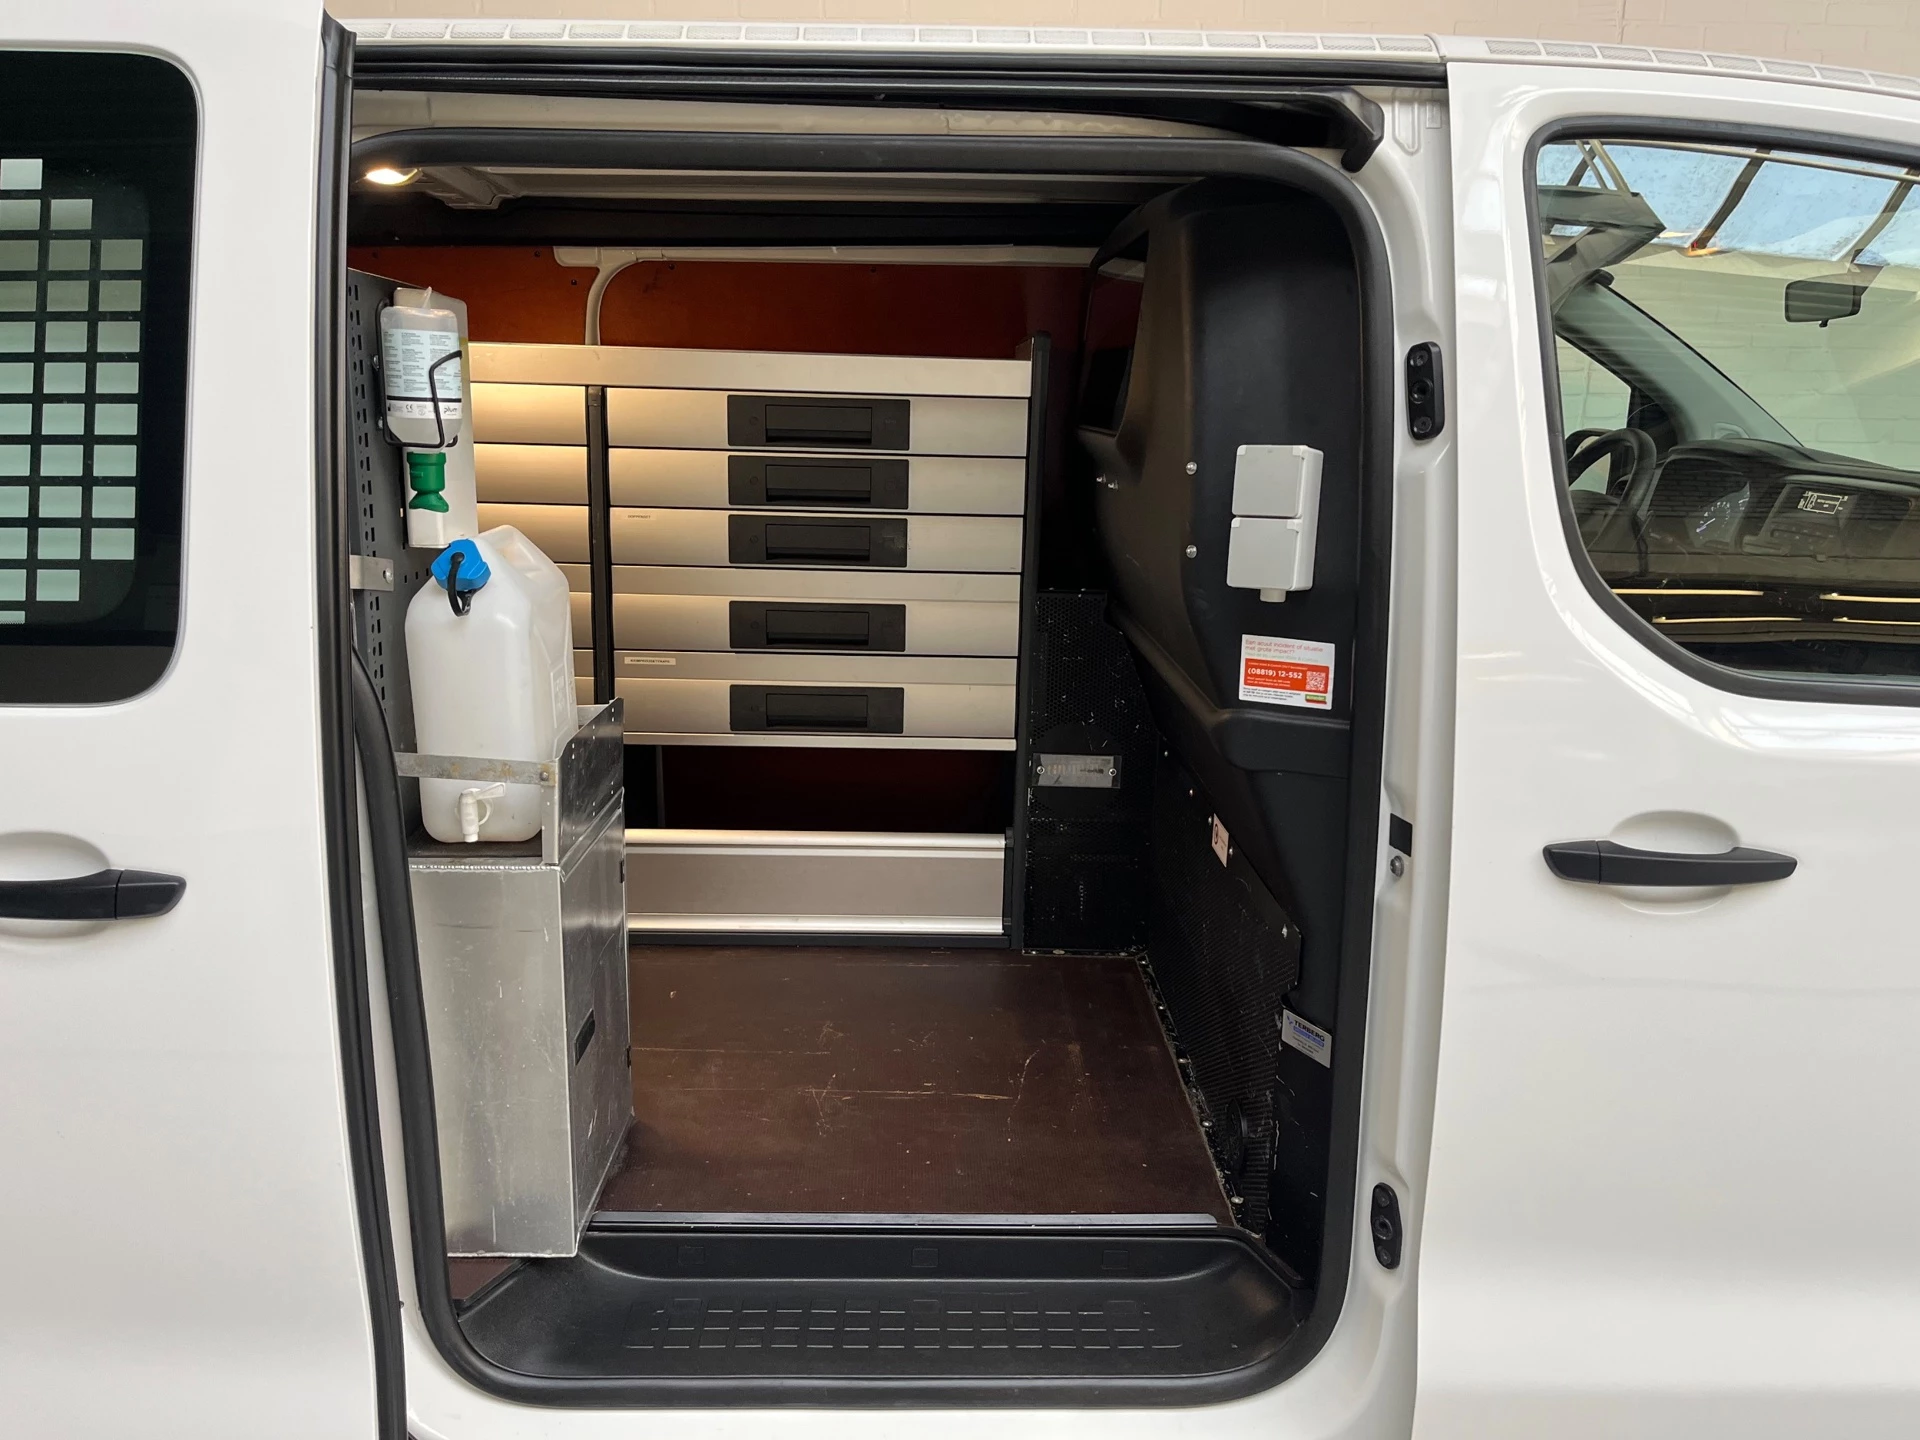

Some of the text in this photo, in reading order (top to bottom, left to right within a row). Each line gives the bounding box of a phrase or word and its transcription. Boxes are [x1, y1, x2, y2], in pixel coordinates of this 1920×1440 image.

[1247, 668, 1303, 679] (08819) 12-552
[1294, 1020, 1325, 1042] TERBERG
